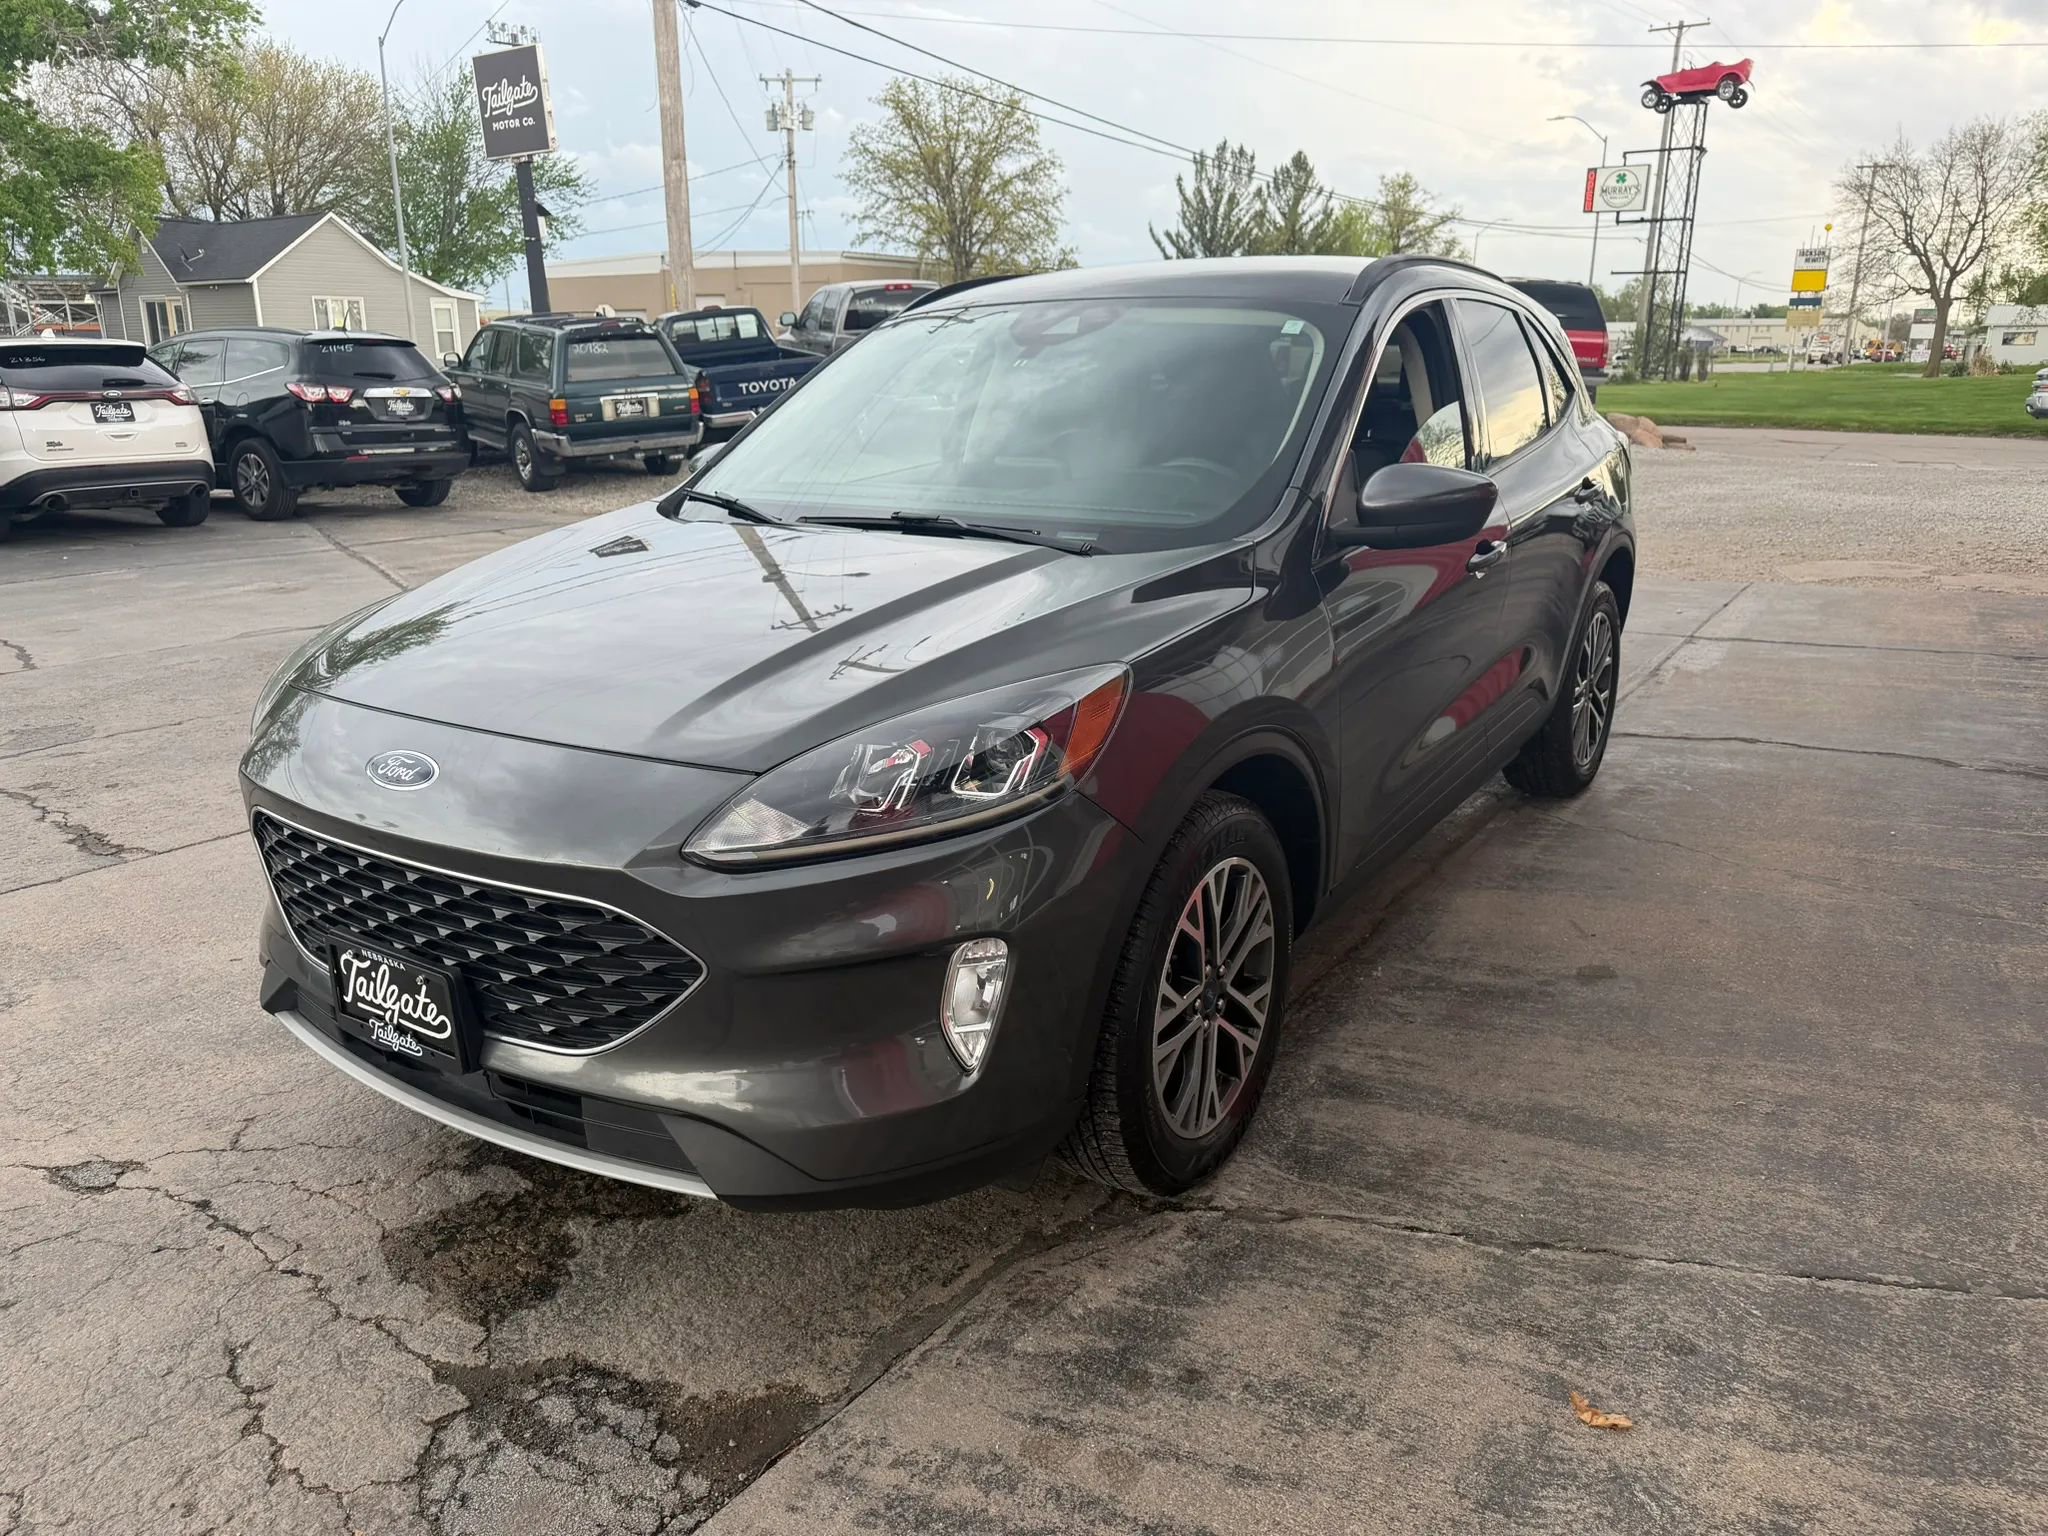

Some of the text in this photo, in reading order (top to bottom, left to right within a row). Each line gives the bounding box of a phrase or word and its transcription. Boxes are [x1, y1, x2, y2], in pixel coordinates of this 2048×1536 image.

[482, 75, 538, 118] Tailgate
[492, 118, 520, 131] MOTOR
[739, 376, 798, 395] TOYOTA
[95, 403, 132, 418] Tailgate
[377, 755, 421, 781] Ford
[361, 949, 406, 971] NEBRASKA
[340, 951, 452, 1039] Tailgate
[368, 1017, 423, 1056] Tailgate
